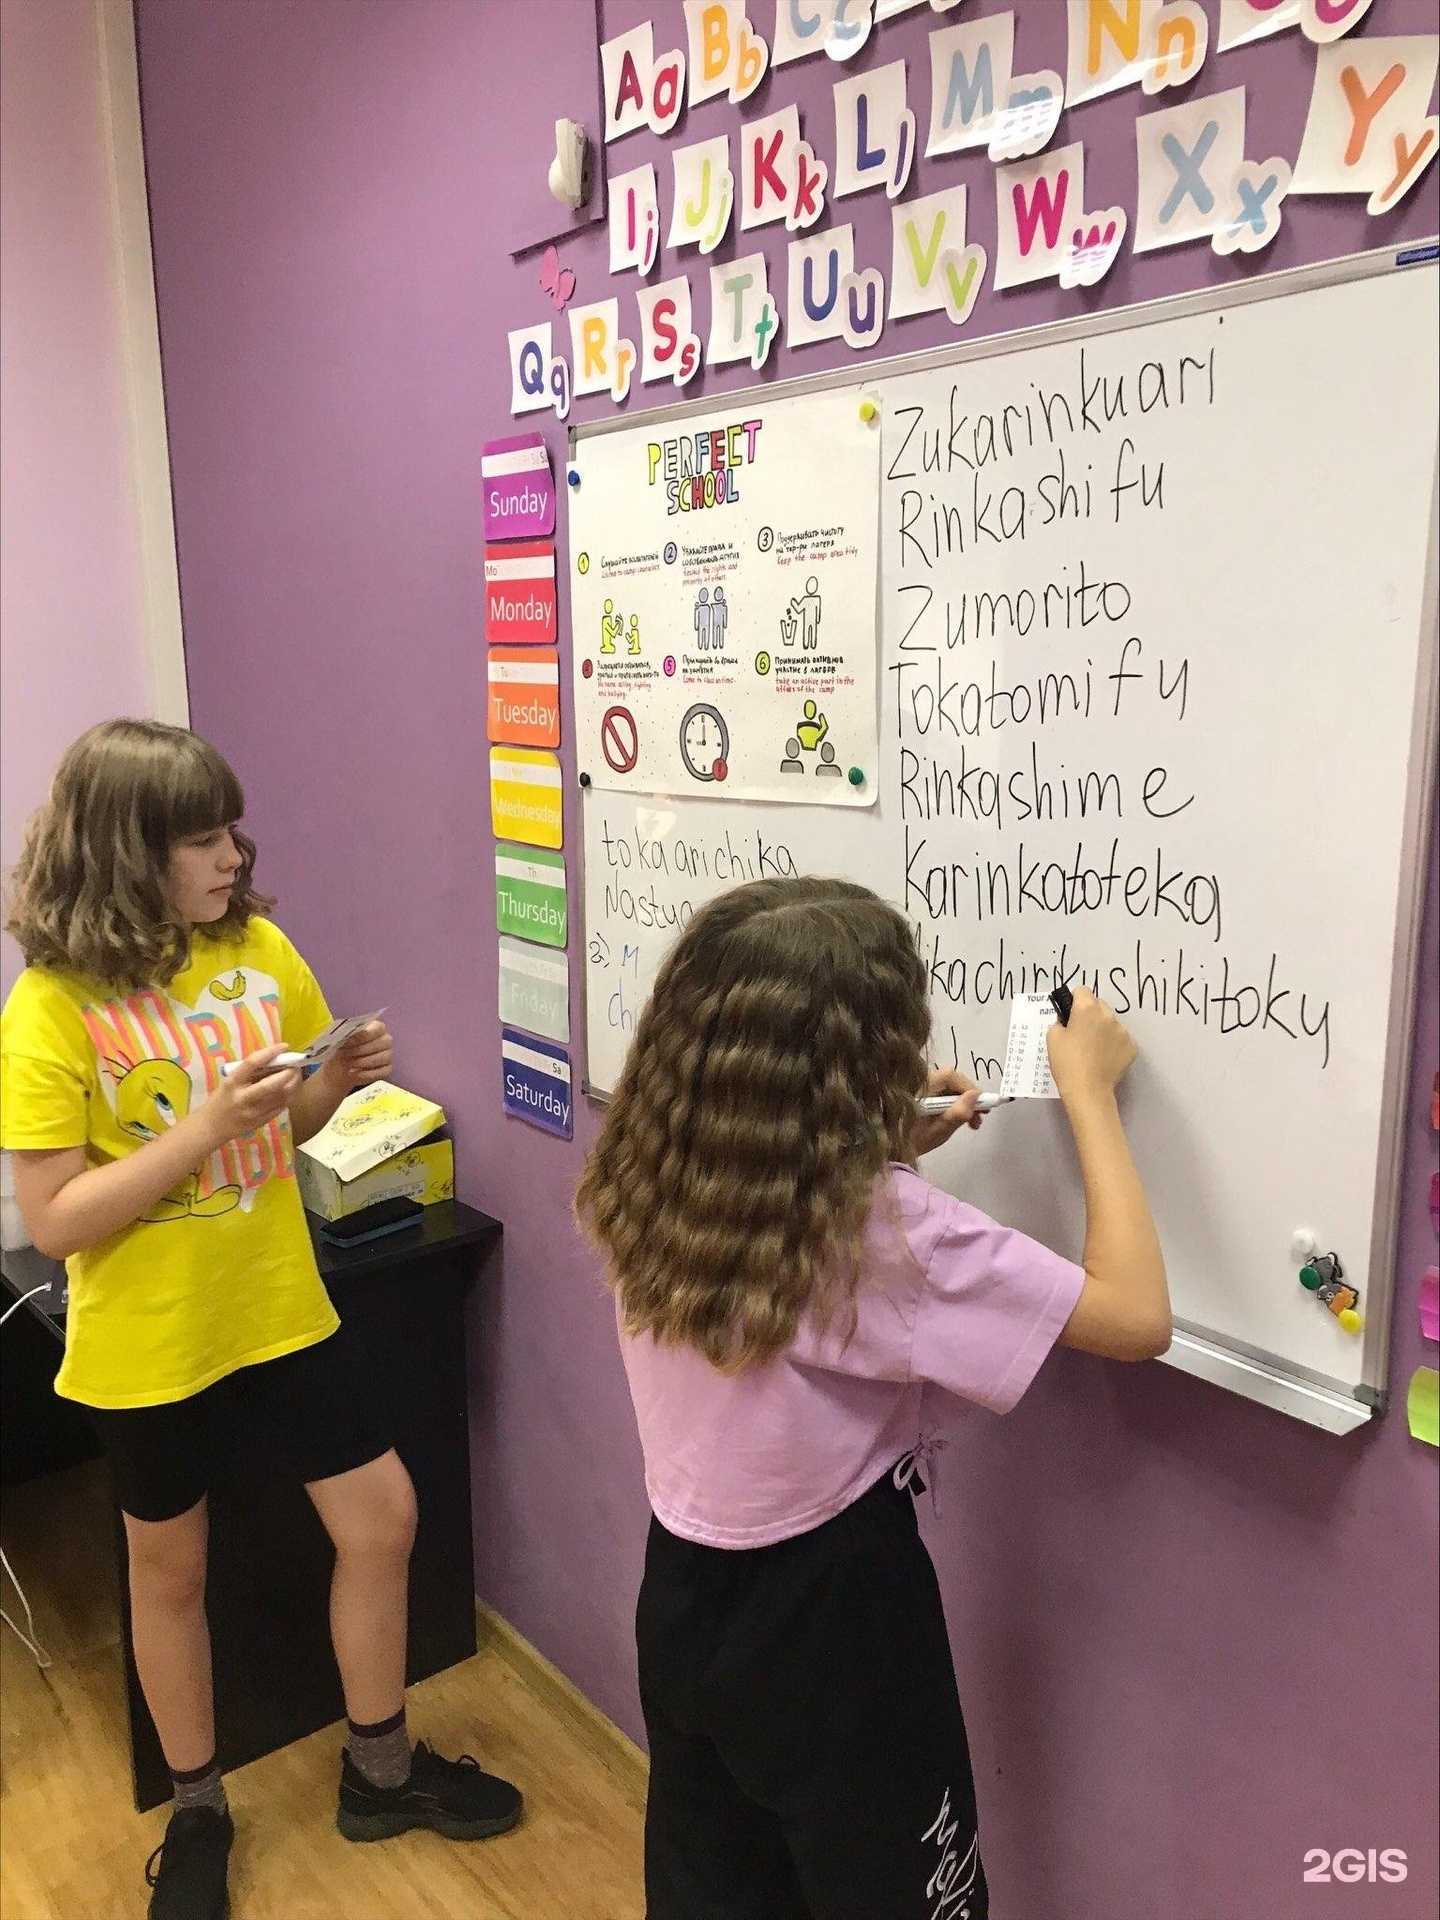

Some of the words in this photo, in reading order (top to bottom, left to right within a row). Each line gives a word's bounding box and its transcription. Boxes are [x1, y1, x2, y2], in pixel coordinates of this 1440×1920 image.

[887, 348, 1214, 480] Zukarinkuari
[647, 419, 762, 485] PERFECT
[490, 485, 548, 520] Sunday
[667, 468, 739, 515] SCHOOL
[490, 596, 552, 629] Monday
[898, 561, 1131, 651] Zumorito
[493, 697, 558, 735] Tuesday
[495, 797, 561, 830] Wednesday
[498, 891, 566, 934] Thursday
[511, 982, 559, 1020] Friday
[552, 1062, 562, 1075] Sa
[506, 1074, 569, 1127] Saturday
